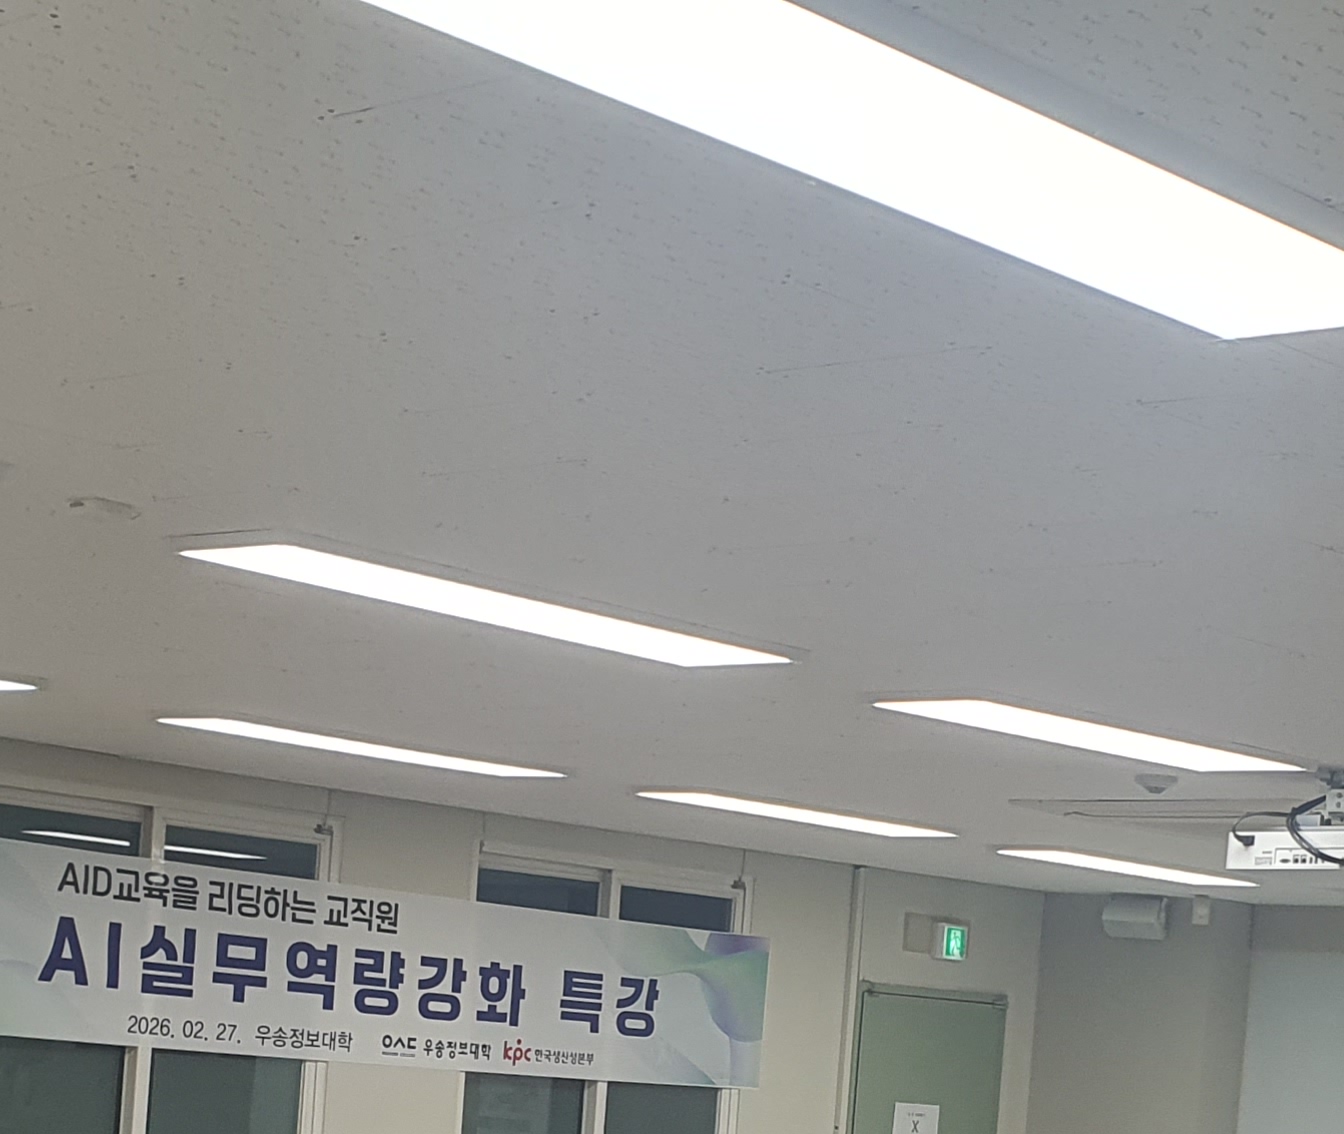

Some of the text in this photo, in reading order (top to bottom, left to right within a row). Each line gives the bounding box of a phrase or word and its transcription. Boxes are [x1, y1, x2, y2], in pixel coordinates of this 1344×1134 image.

[57, 862, 400, 935] AID교육을 리딩하는 교직원
[559, 969, 661, 1038] 특강
[126, 1014, 354, 1053] 2026. 02. 27. 우송정보대학
[423, 1038, 491, 1061] 우송정보대학
